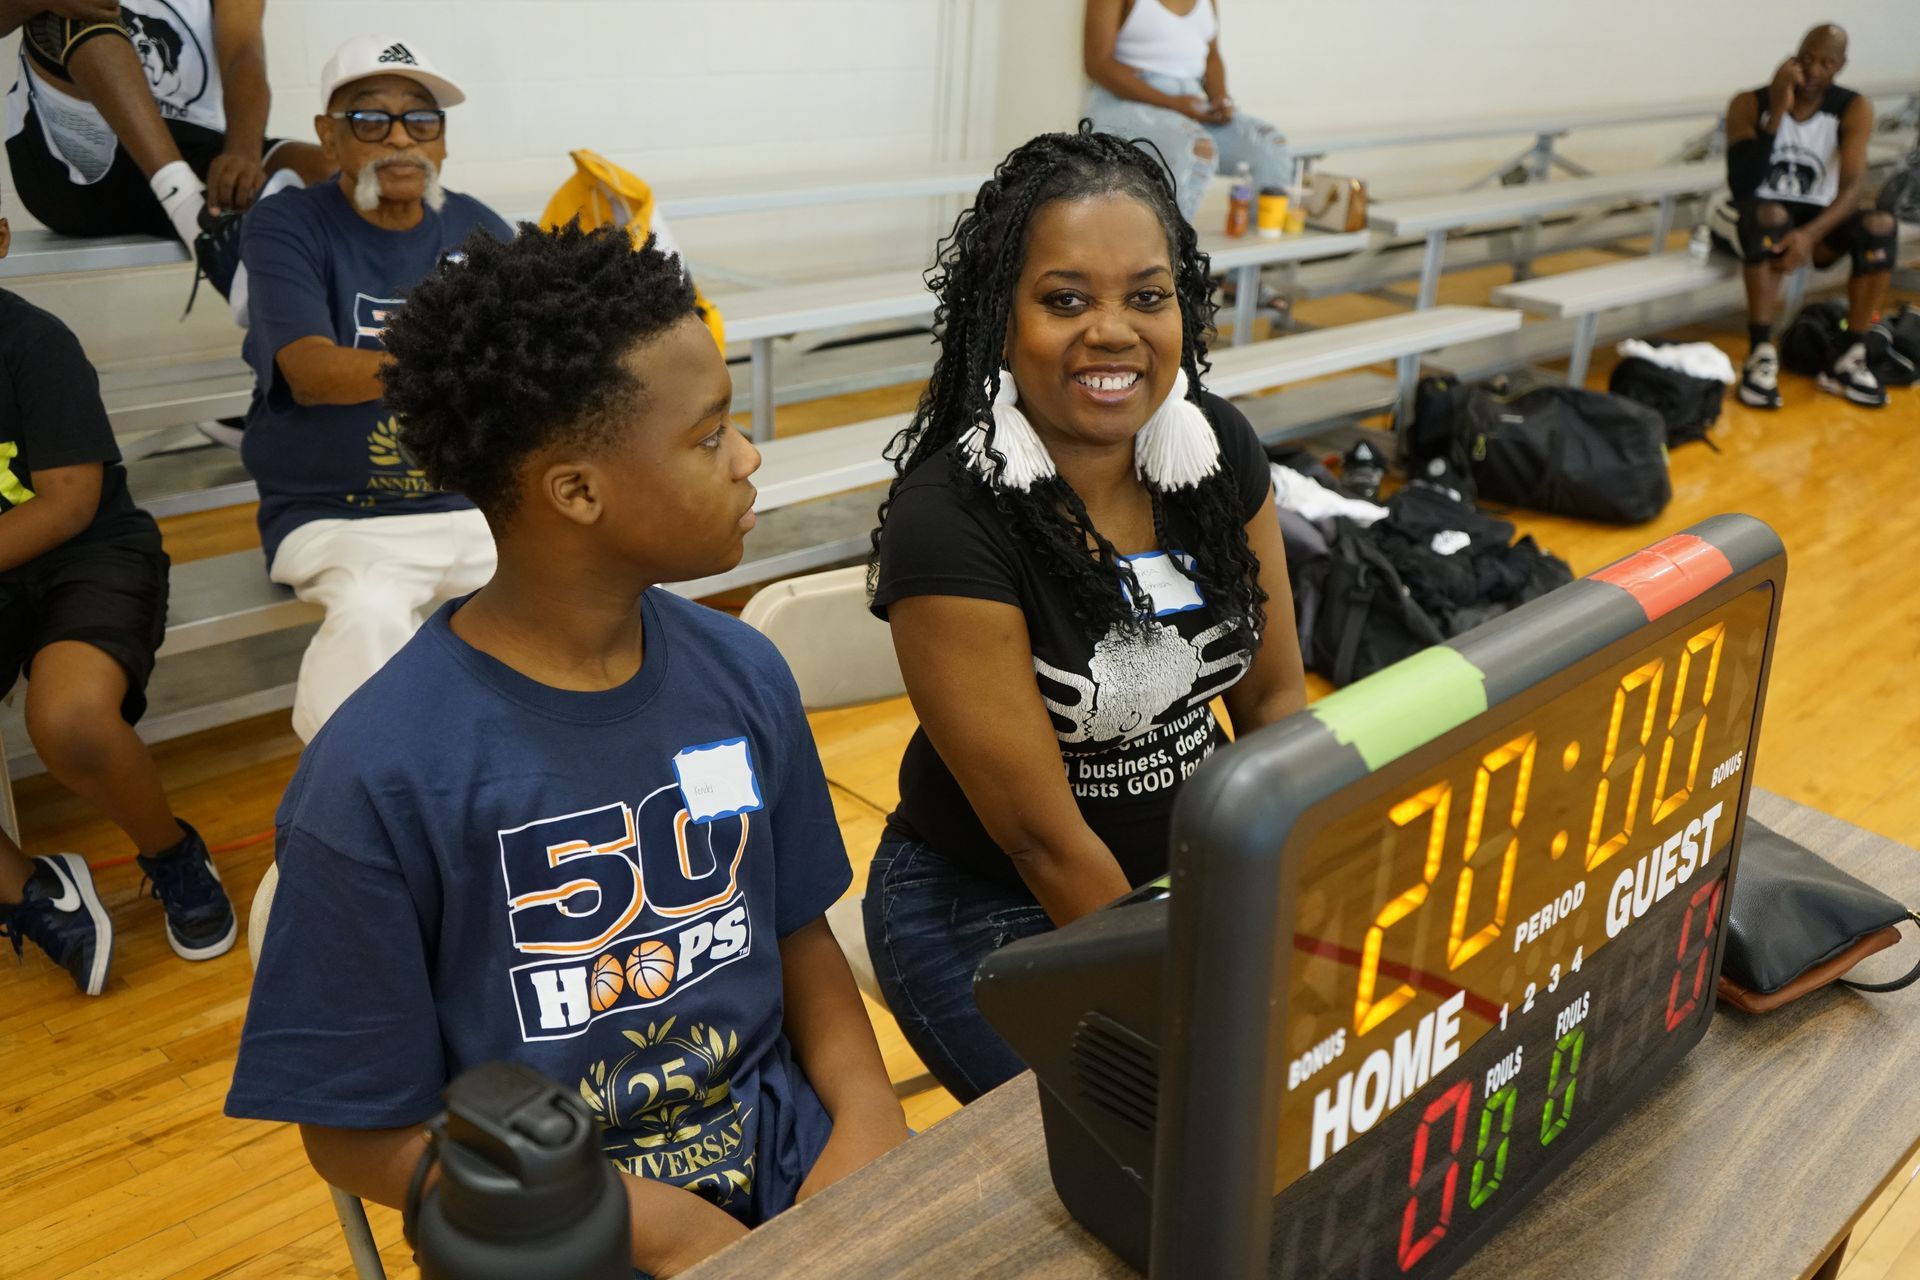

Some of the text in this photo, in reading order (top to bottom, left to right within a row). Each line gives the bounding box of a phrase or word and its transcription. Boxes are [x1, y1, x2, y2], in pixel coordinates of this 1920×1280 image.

[1070, 783, 1120, 799] usts
[1127, 767, 1175, 795] GOD
[1079, 748, 1174, 779] business,
[1175, 724, 1208, 757] does
[1711, 751, 1743, 789] BONUS
[498, 782, 749, 955] 50
[1355, 621, 1725, 1036] 20:00
[1606, 801, 1724, 939] GUEST
[1514, 881, 1586, 953] PERIOD
[1665, 874, 1724, 1032] 0
[1500, 945, 1584, 1031] 1 2 3 4
[1555, 991, 1590, 1040] FOULS
[1288, 1027, 1347, 1091] BONUS
[1309, 990, 1466, 1172] HOME
[1485, 1045, 1523, 1098] FOULS
[1540, 1026, 1585, 1146] 0
[1397, 1079, 1472, 1272] 0
[1468, 1084, 1517, 1210] 0
